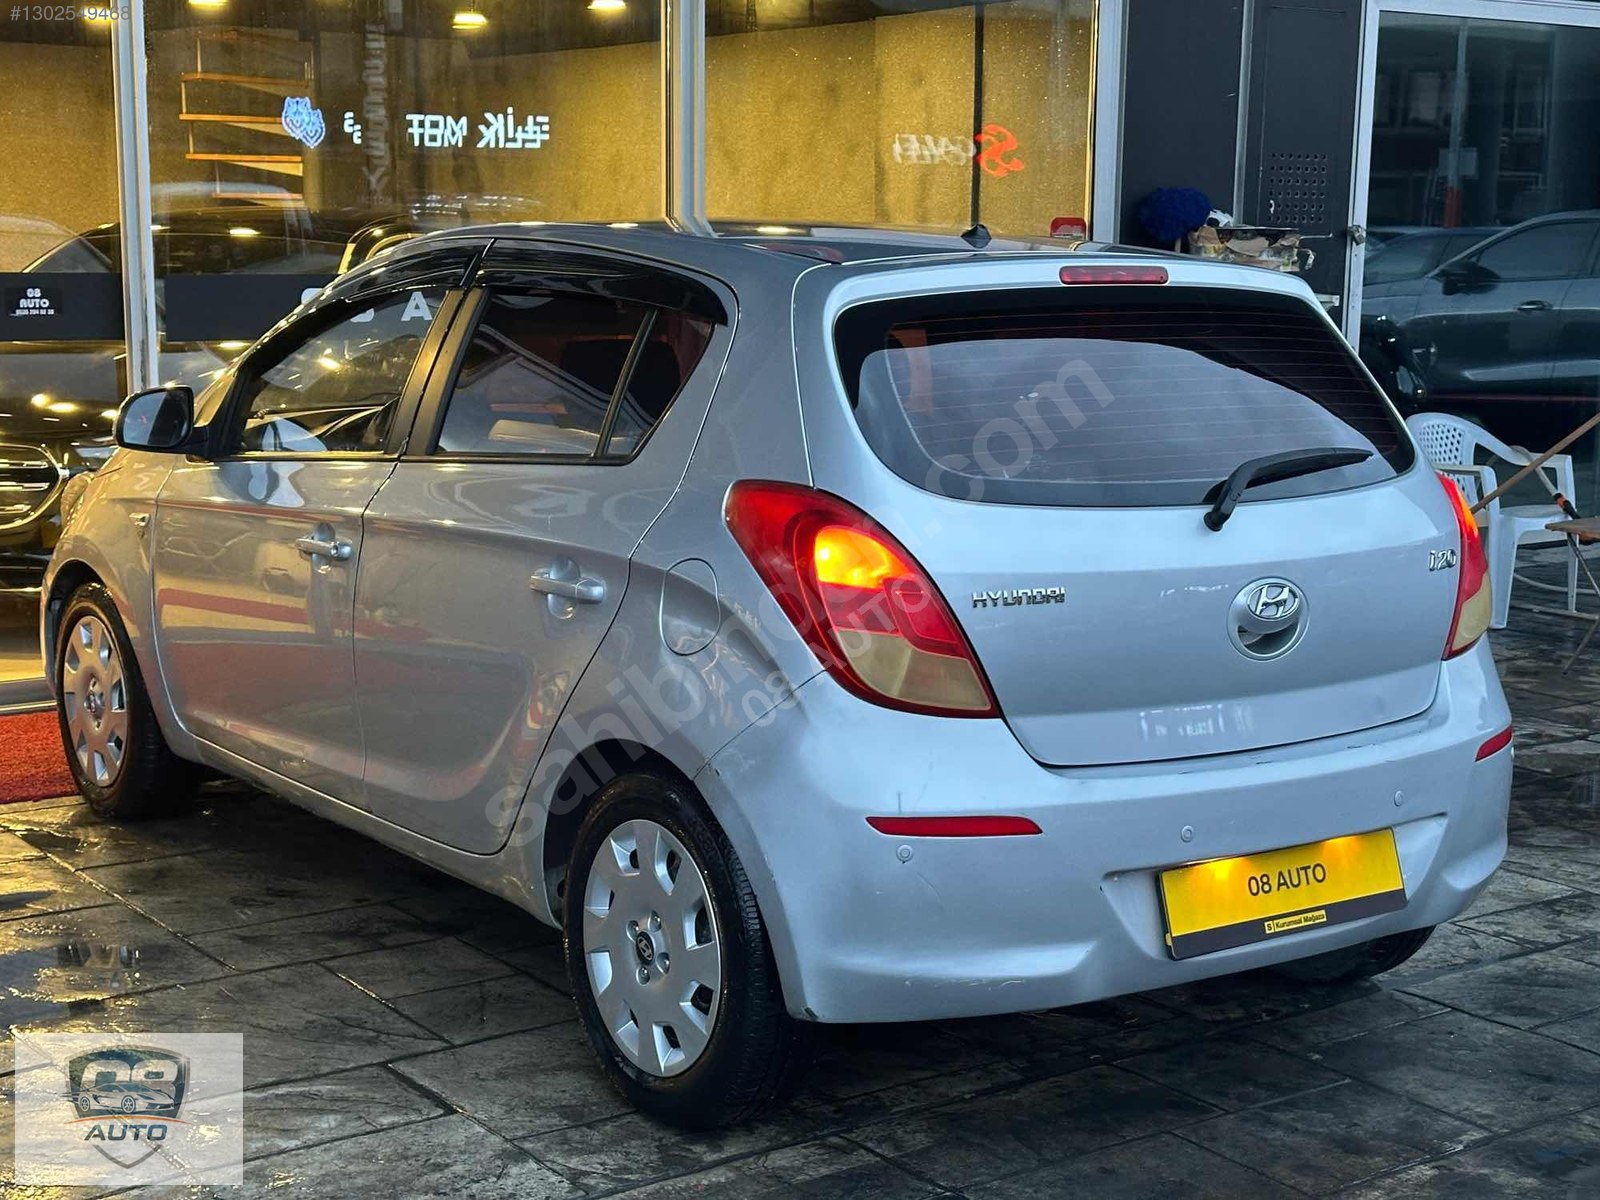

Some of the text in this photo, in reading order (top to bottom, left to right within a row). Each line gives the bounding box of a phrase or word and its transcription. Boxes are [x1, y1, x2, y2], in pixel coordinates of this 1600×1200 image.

[19, 298, 50, 308] AUTO
[972, 586, 1065, 609] HYUNDAI
[1247, 863, 1326, 896] 08 AUTO
